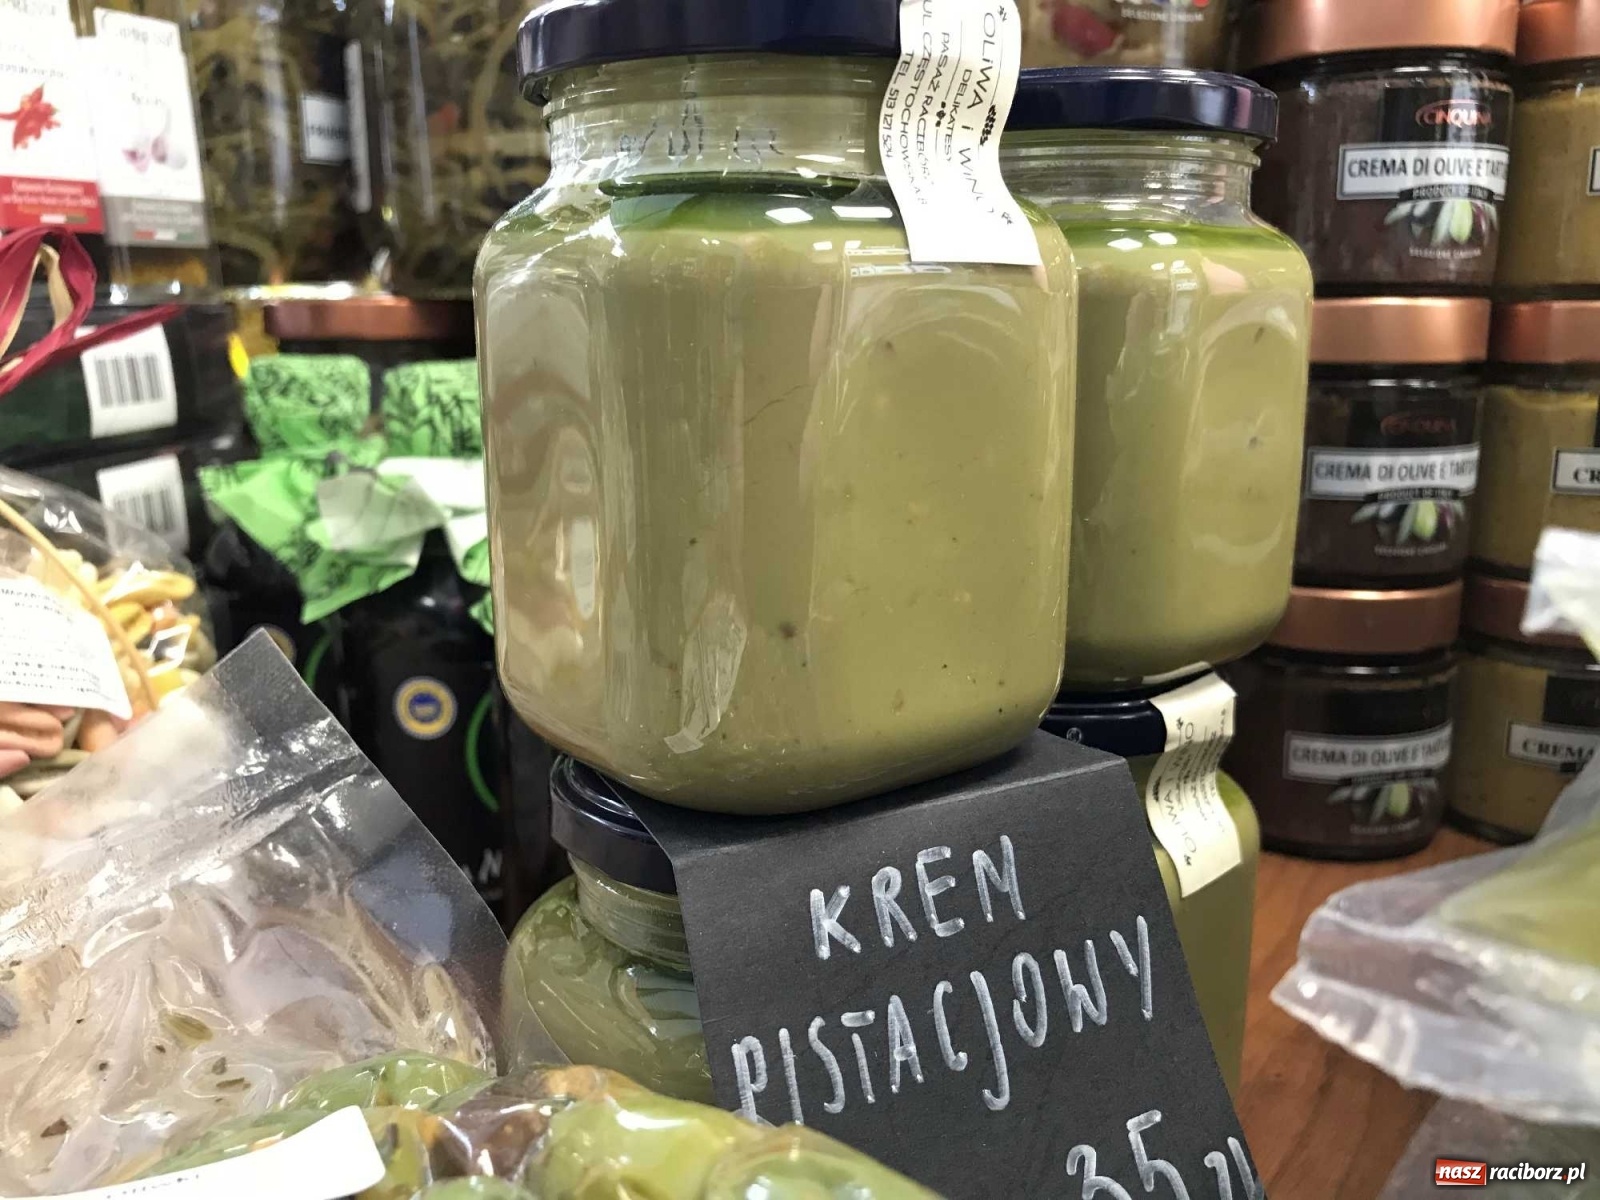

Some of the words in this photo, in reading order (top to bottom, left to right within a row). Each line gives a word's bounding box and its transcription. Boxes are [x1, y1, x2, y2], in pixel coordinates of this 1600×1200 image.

[892, 48, 915, 85] TEL
[927, 31, 950, 92] PASAŻ
[885, 87, 900, 110] 513
[882, 112, 894, 131] 121
[882, 133, 894, 158] 524
[1347, 156, 1407, 179] CREMA
[1412, 157, 1429, 177] DI
[1433, 156, 1473, 178] OLIVE
[1475, 157, 1482, 177] E
[1314, 458, 1371, 481] CREMA
[1377, 461, 1394, 482] DI
[1397, 461, 1436, 482] OLIVE
[1439, 460, 1446, 481] E
[1292, 745, 1347, 766] CREMA
[1352, 749, 1367, 767] DI
[1371, 747, 1409, 766] OLIVE
[808, 834, 1027, 961] KREM
[731, 914, 1154, 1127] PISTACJOWY
[1065, 1109, 1191, 1200] 35
